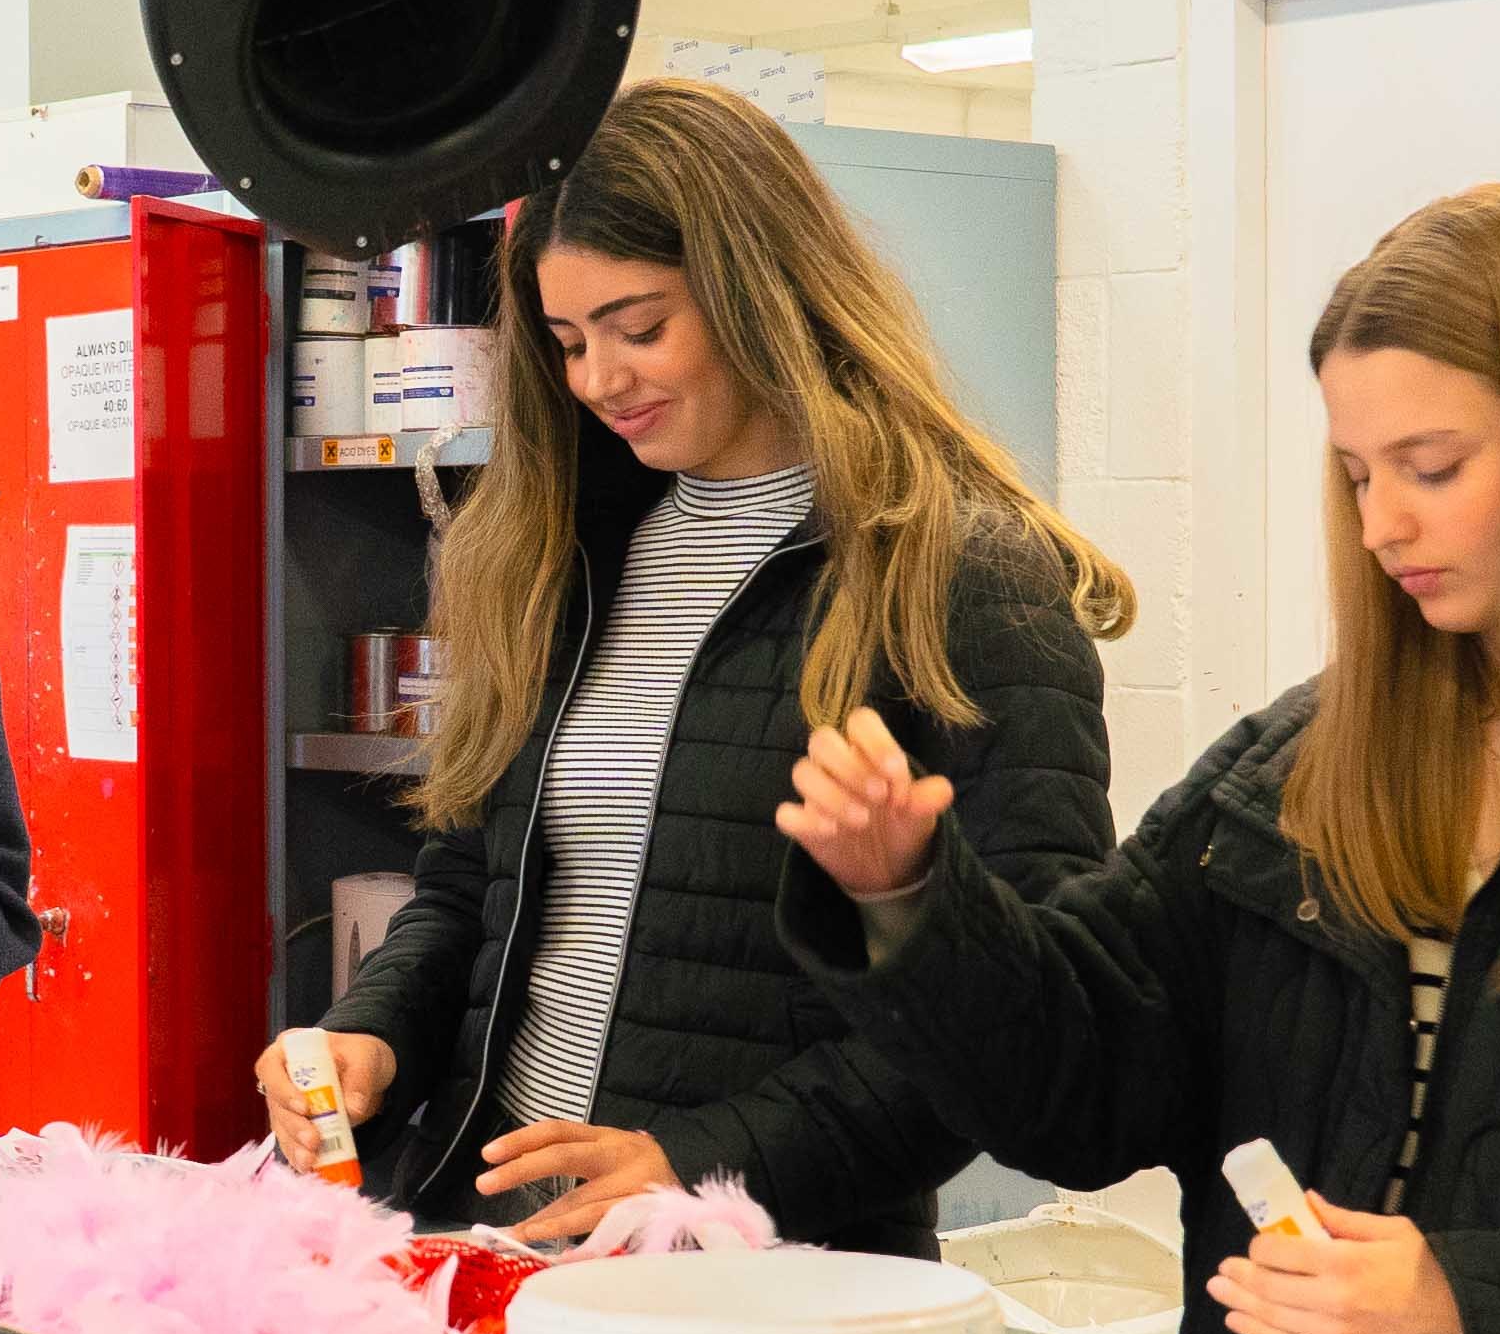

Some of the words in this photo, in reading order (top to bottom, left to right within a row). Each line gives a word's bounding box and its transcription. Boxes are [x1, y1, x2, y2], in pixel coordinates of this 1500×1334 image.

[75, 341, 117, 358] ALWAYS
[60, 361, 101, 379] OPAQUE
[103, 358, 134, 375] WHITE
[70, 380, 121, 398] STANDARD
[103, 398, 128, 413] 40:60
[67, 418, 100, 433] OPAQUE
[338, 446, 357, 457] ACID
[358, 445, 377, 457] DYES
